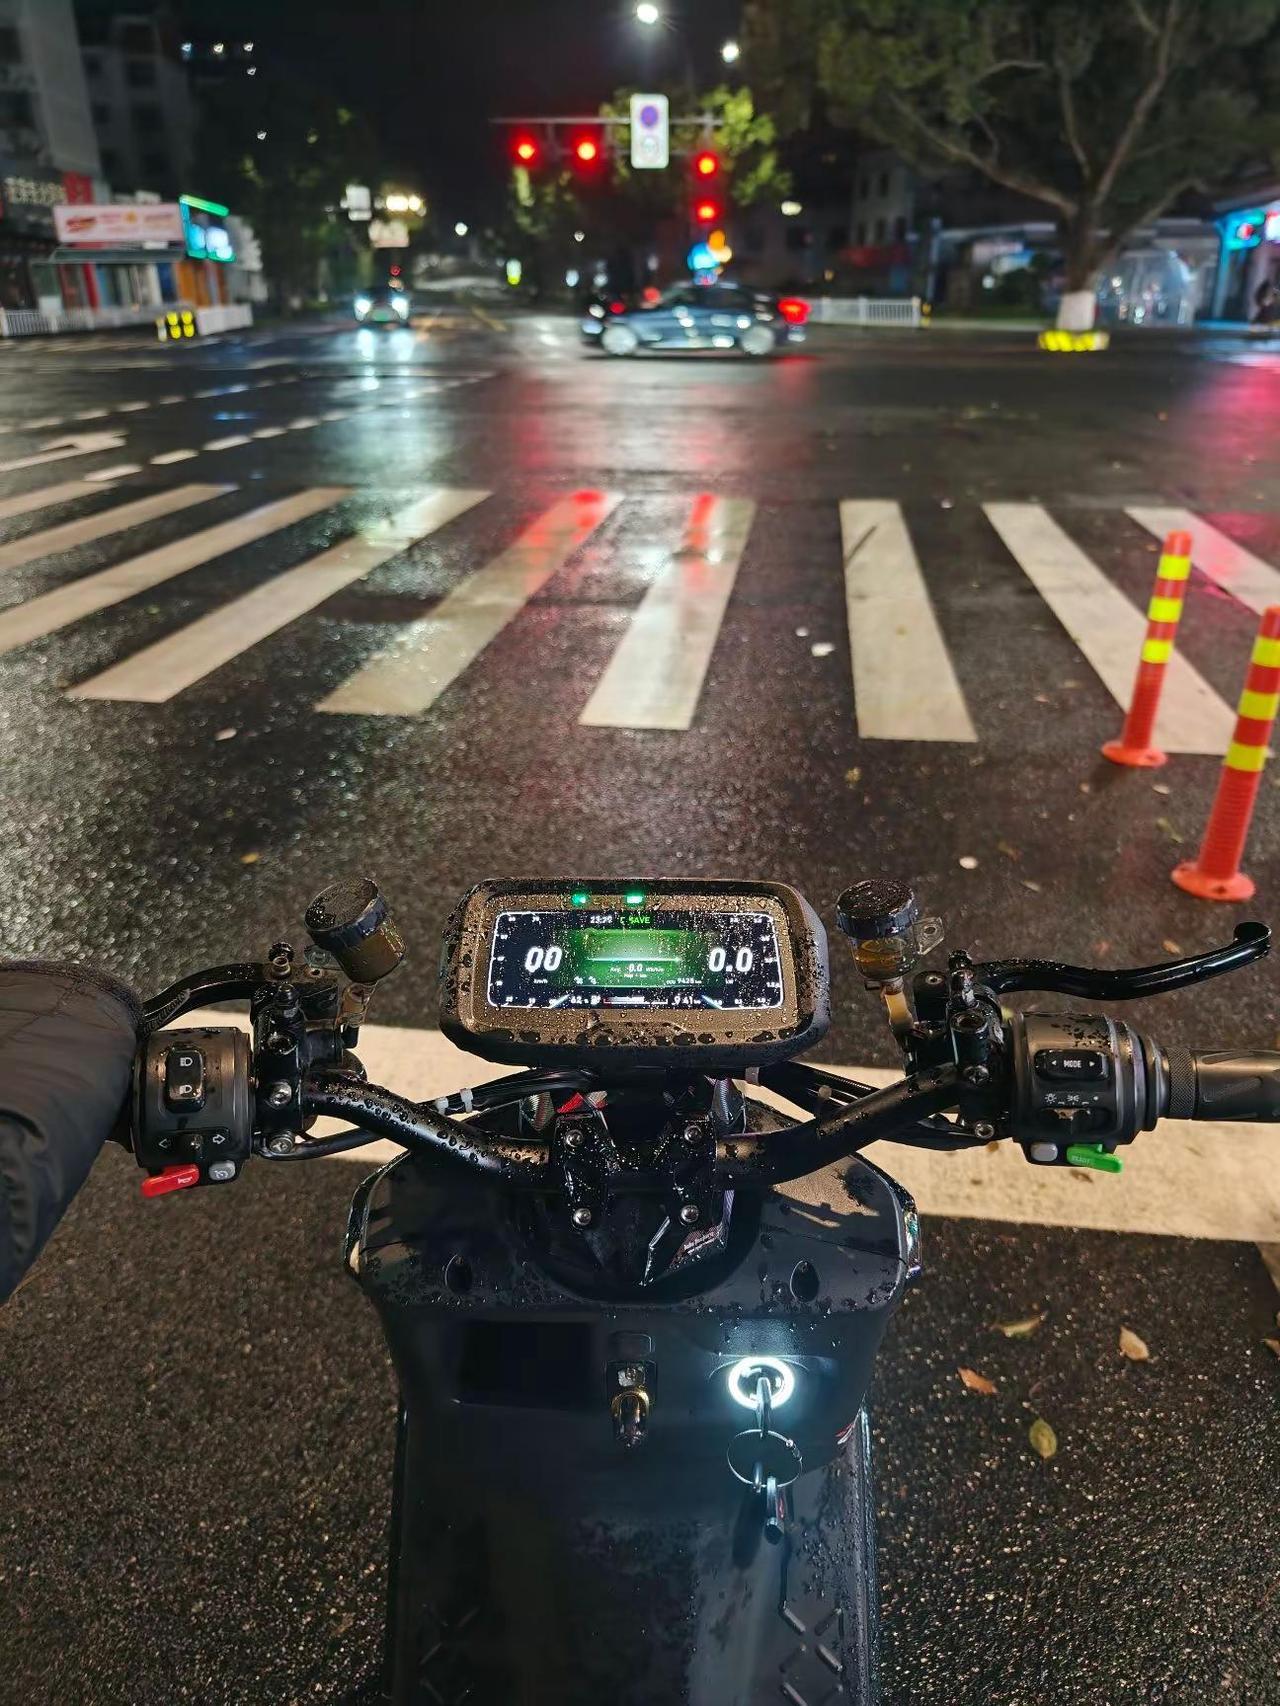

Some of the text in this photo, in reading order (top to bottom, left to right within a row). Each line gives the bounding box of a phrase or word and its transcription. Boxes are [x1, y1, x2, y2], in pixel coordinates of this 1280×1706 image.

[524, 946, 562, 972] 00
[708, 947, 753, 972] 0.0
[1063, 1059, 1082, 1069] MODE
